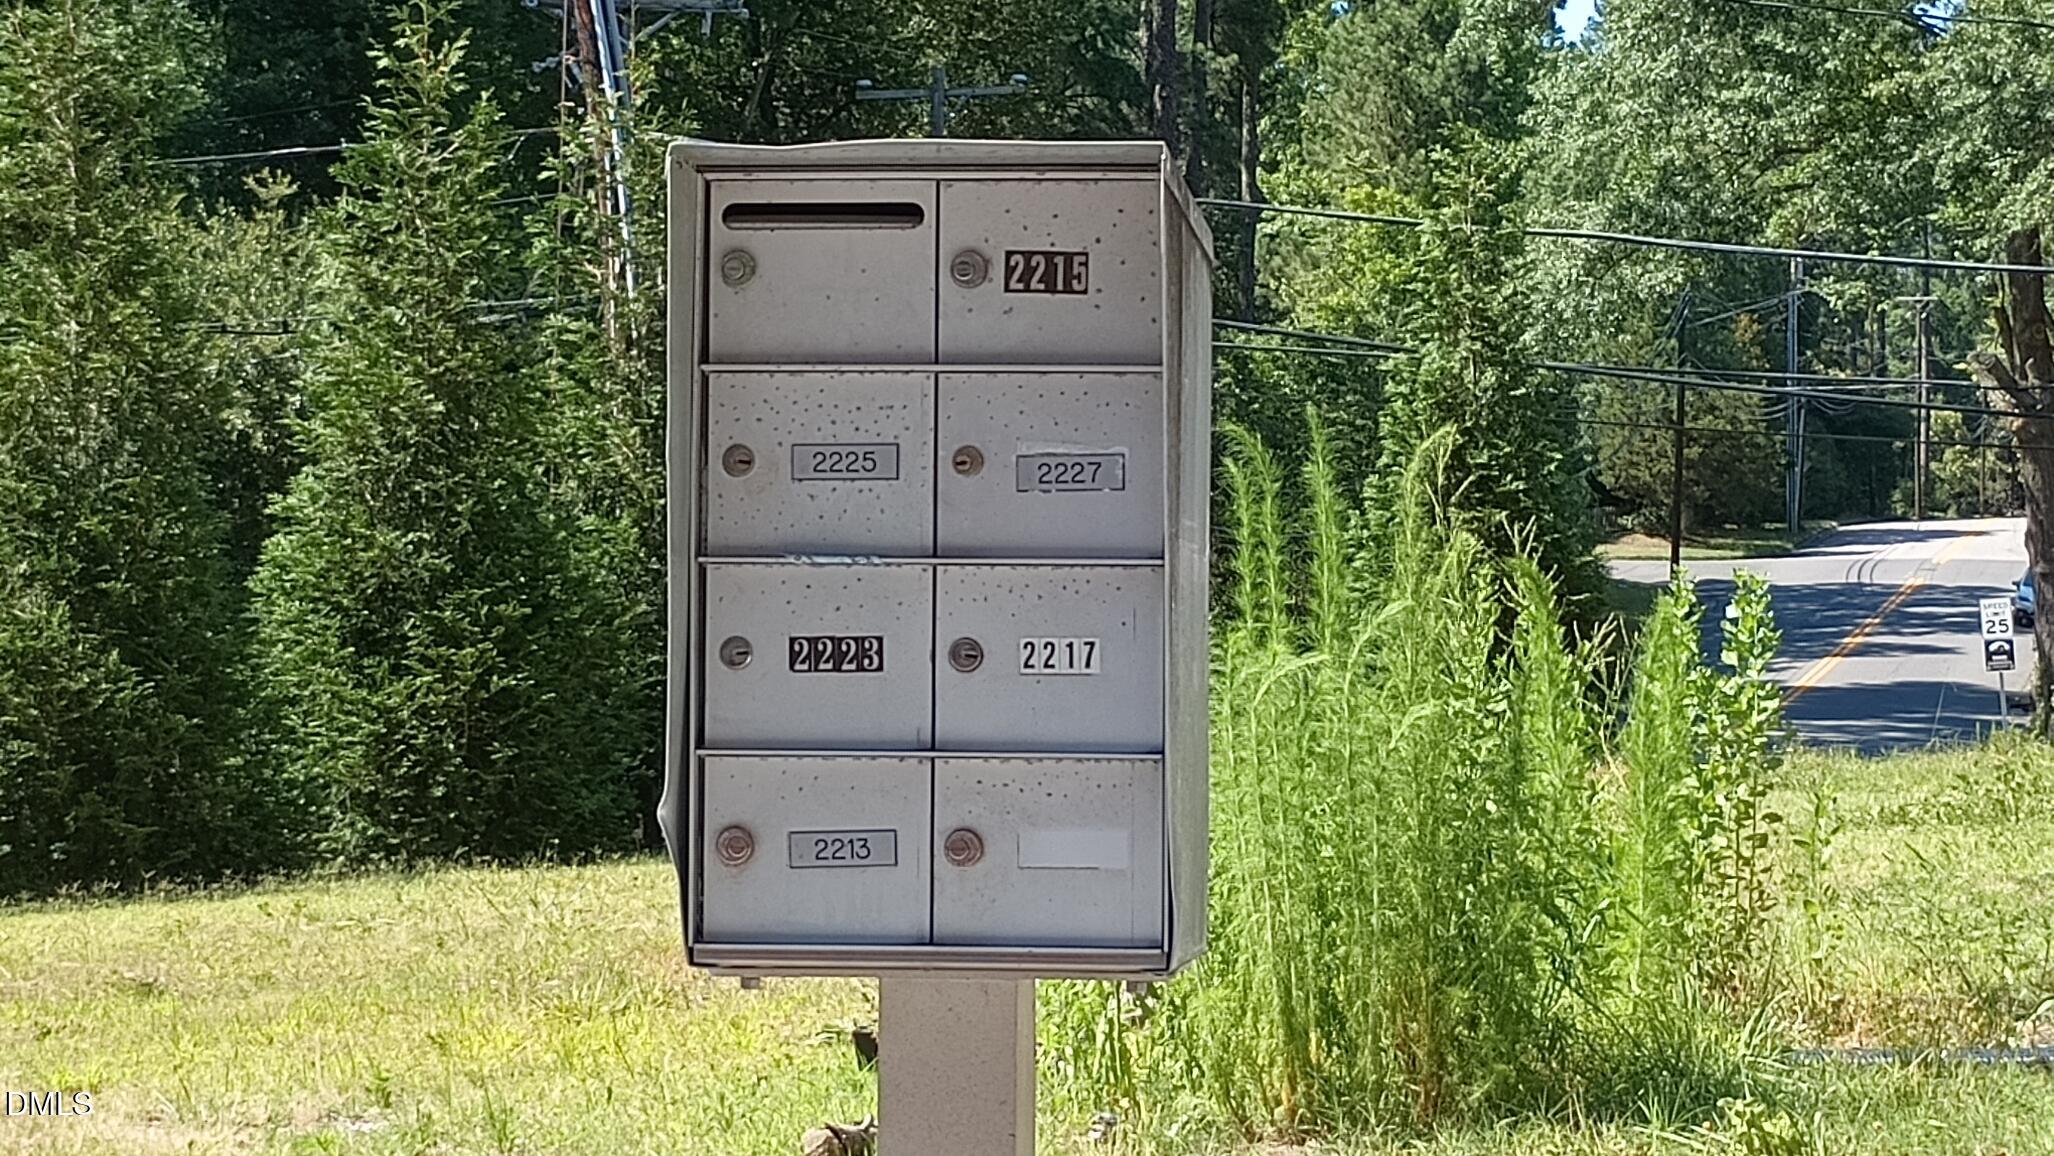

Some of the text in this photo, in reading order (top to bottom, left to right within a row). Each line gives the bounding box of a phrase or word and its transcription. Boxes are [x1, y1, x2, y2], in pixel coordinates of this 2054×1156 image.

[1008, 253, 1087, 291] 2215
[812, 451, 877, 473] 2225
[1037, 462, 1102, 484] 2227
[1985, 618, 2010, 634] 25
[793, 638, 880, 671] 2223
[1023, 641, 1096, 669] 2217
[814, 838, 871, 860] 2213
